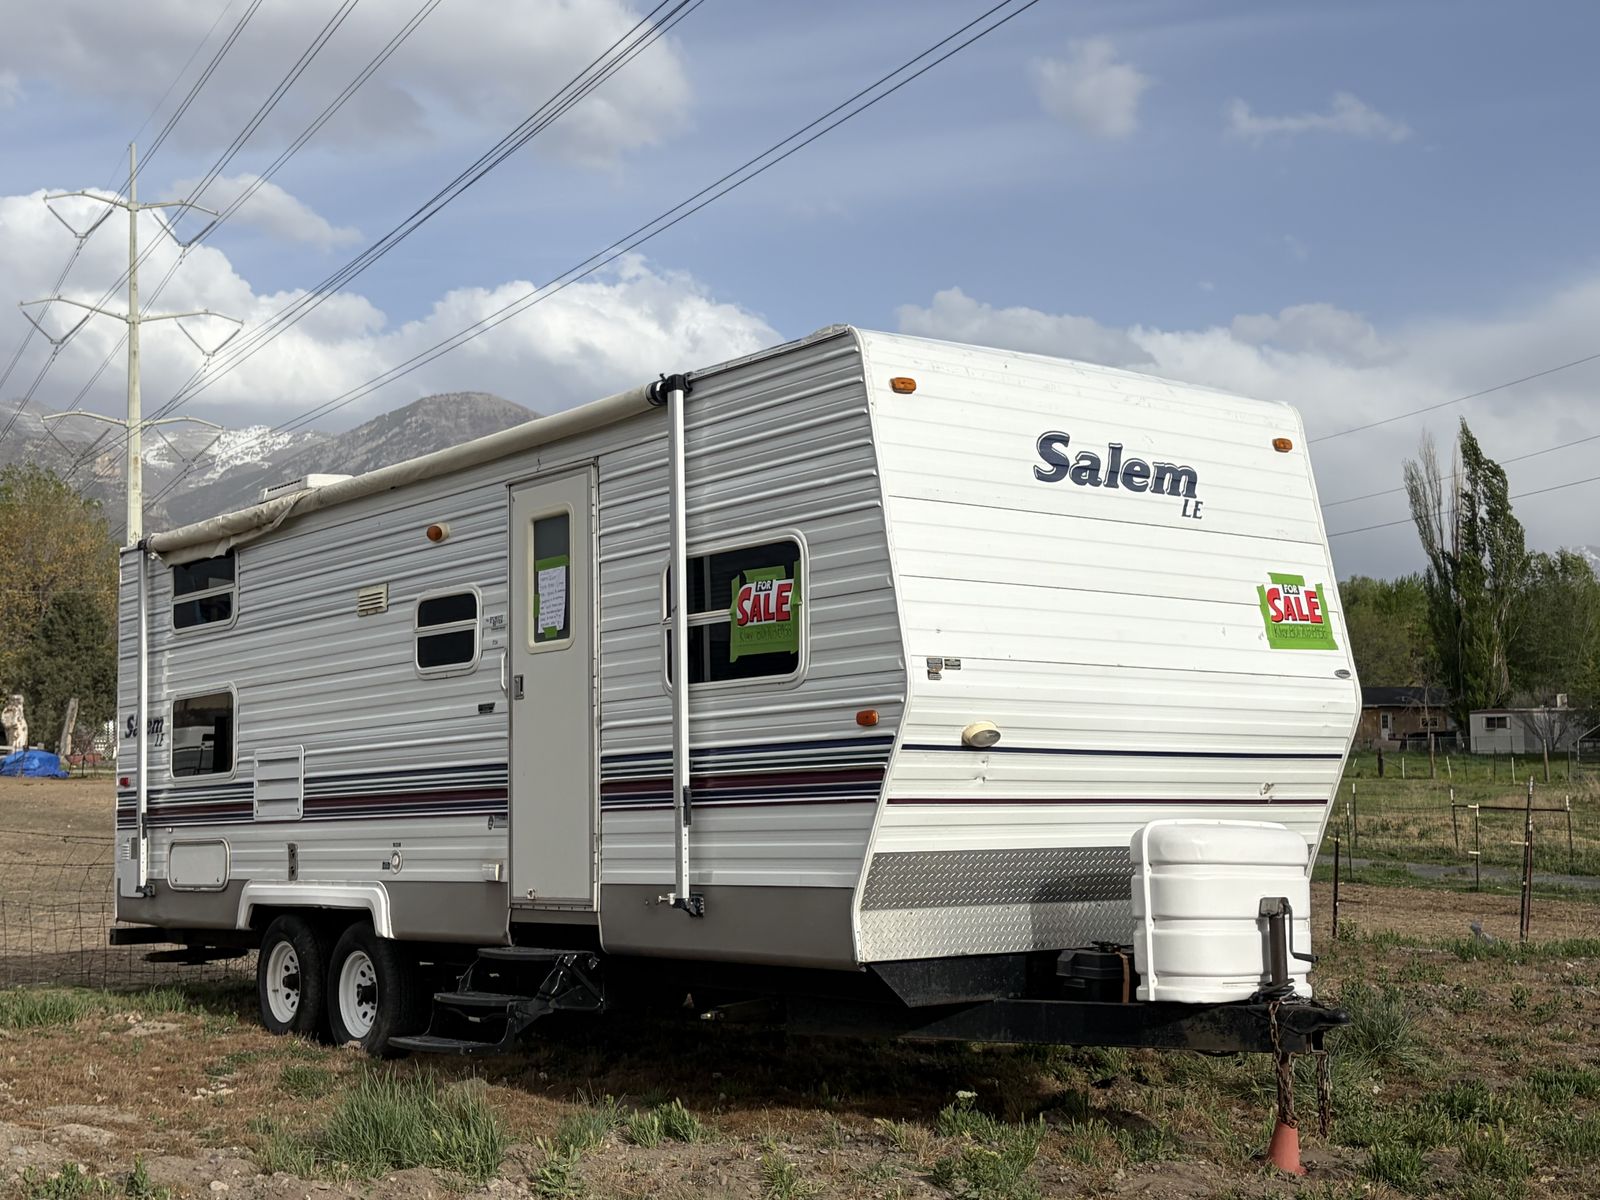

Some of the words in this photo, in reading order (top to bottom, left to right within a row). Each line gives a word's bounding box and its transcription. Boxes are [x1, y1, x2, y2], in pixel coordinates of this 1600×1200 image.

[1033, 430, 1198, 498] Salem
[1181, 499, 1203, 519] LE
[757, 581, 772, 591] FOR
[1284, 584, 1299, 594] FOR
[737, 583, 793, 626] SALE
[1266, 587, 1323, 624] SALE
[125, 714, 164, 738] Sem
